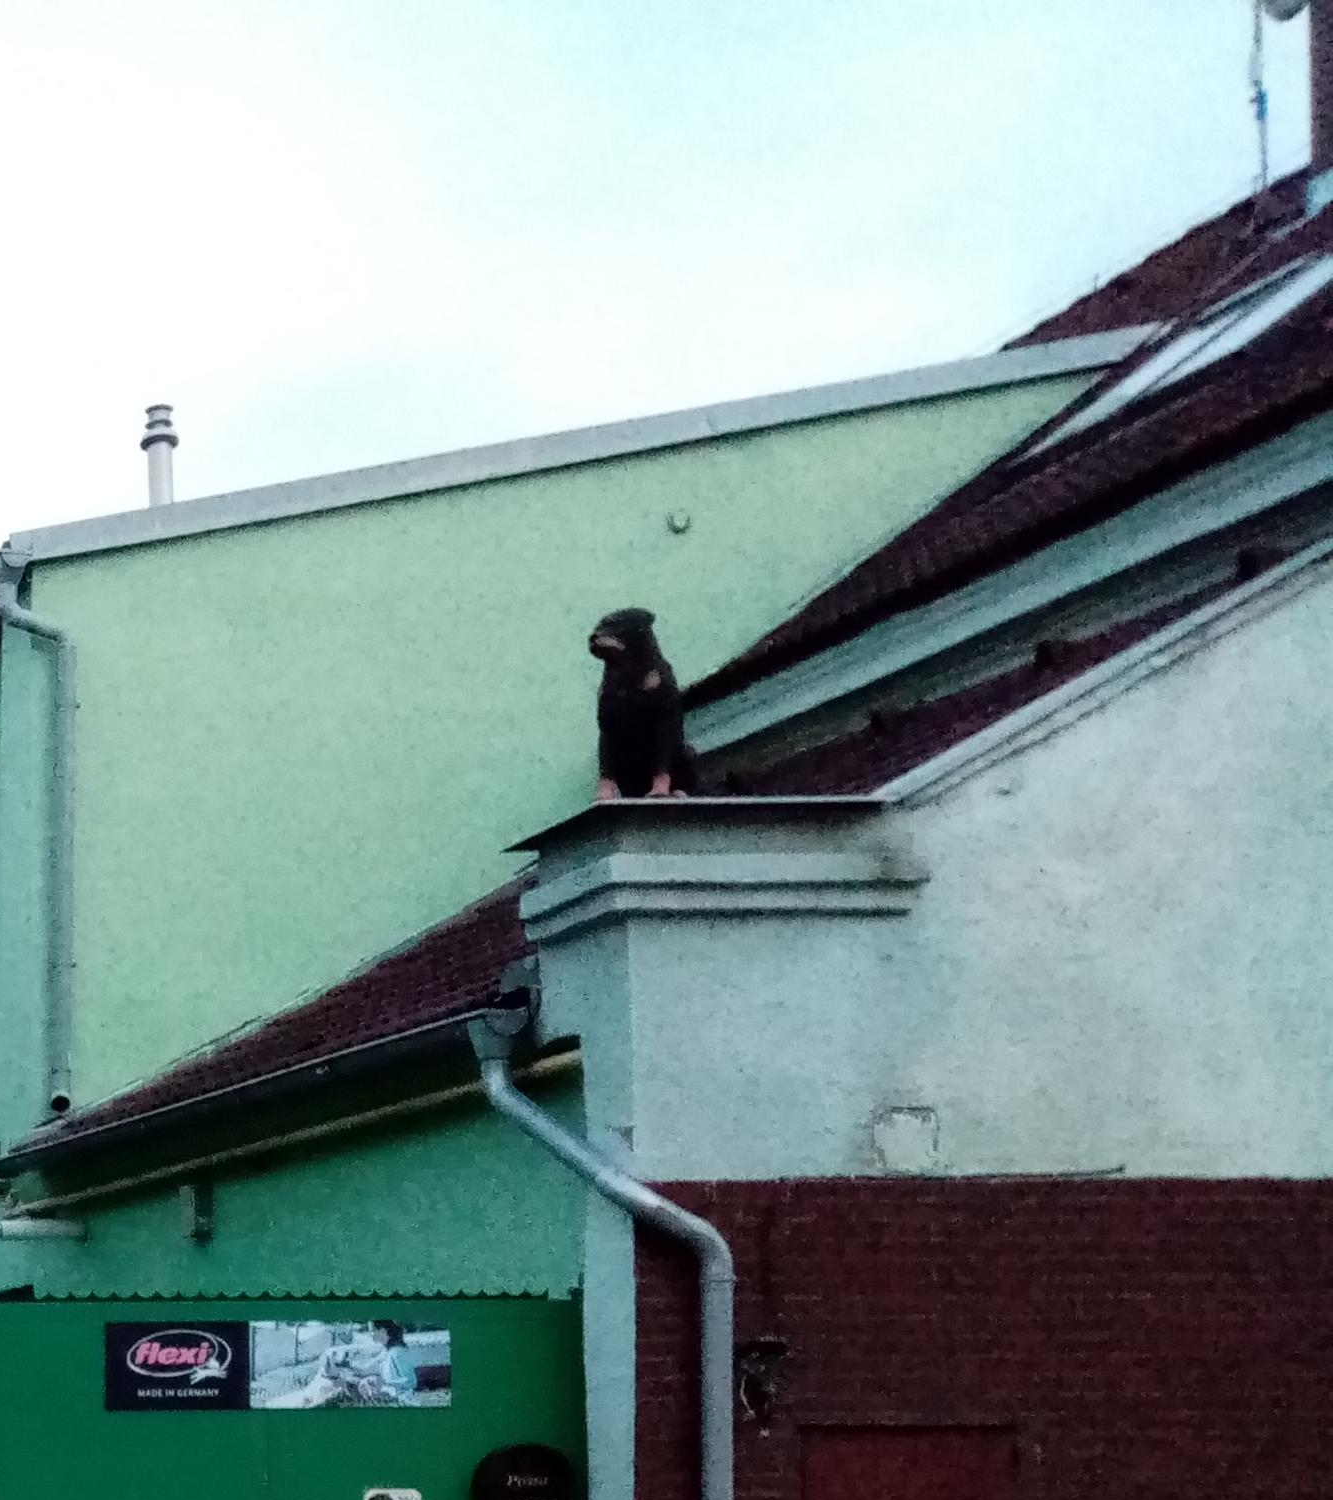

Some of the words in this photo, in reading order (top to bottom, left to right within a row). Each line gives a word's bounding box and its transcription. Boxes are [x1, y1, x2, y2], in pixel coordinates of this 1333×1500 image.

[135, 1342, 209, 1366] flexi
[137, 1388, 162, 1398] MADE
[165, 1388, 175, 1398] IN
[177, 1388, 219, 1398] GERMANY
